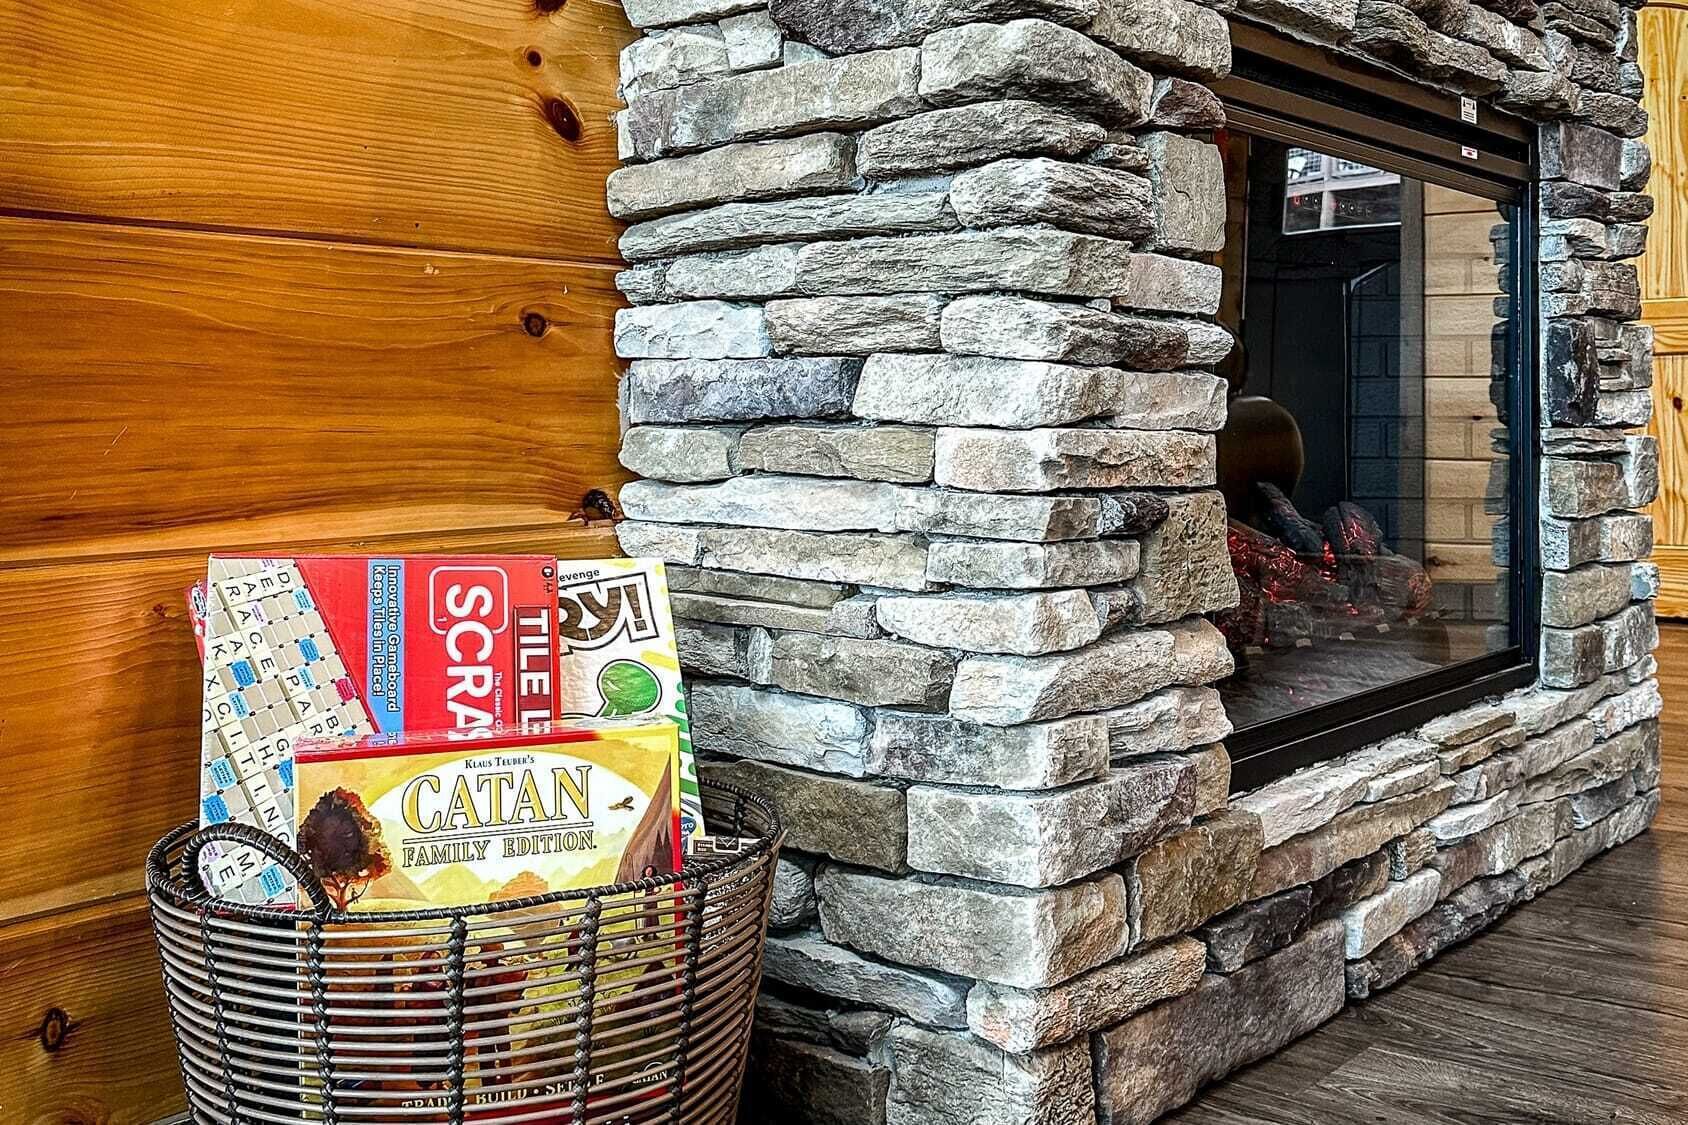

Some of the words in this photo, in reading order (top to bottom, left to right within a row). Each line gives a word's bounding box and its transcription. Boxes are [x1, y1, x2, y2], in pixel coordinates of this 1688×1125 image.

[371, 565, 387, 605] Keeps
[558, 568, 600, 583] evenge
[387, 565, 401, 629] Innovative
[373, 607, 386, 637] Tiles
[373, 640, 386, 652] in
[446, 583, 494, 729] SCRA
[519, 608, 551, 697] TILE
[373, 655, 386, 697] Place!
[387, 632, 401, 713] Gameboard
[401, 765, 593, 834] CATAN
[402, 839, 491, 868] FAMILY
[545, 1073, 604, 1096] SETE
